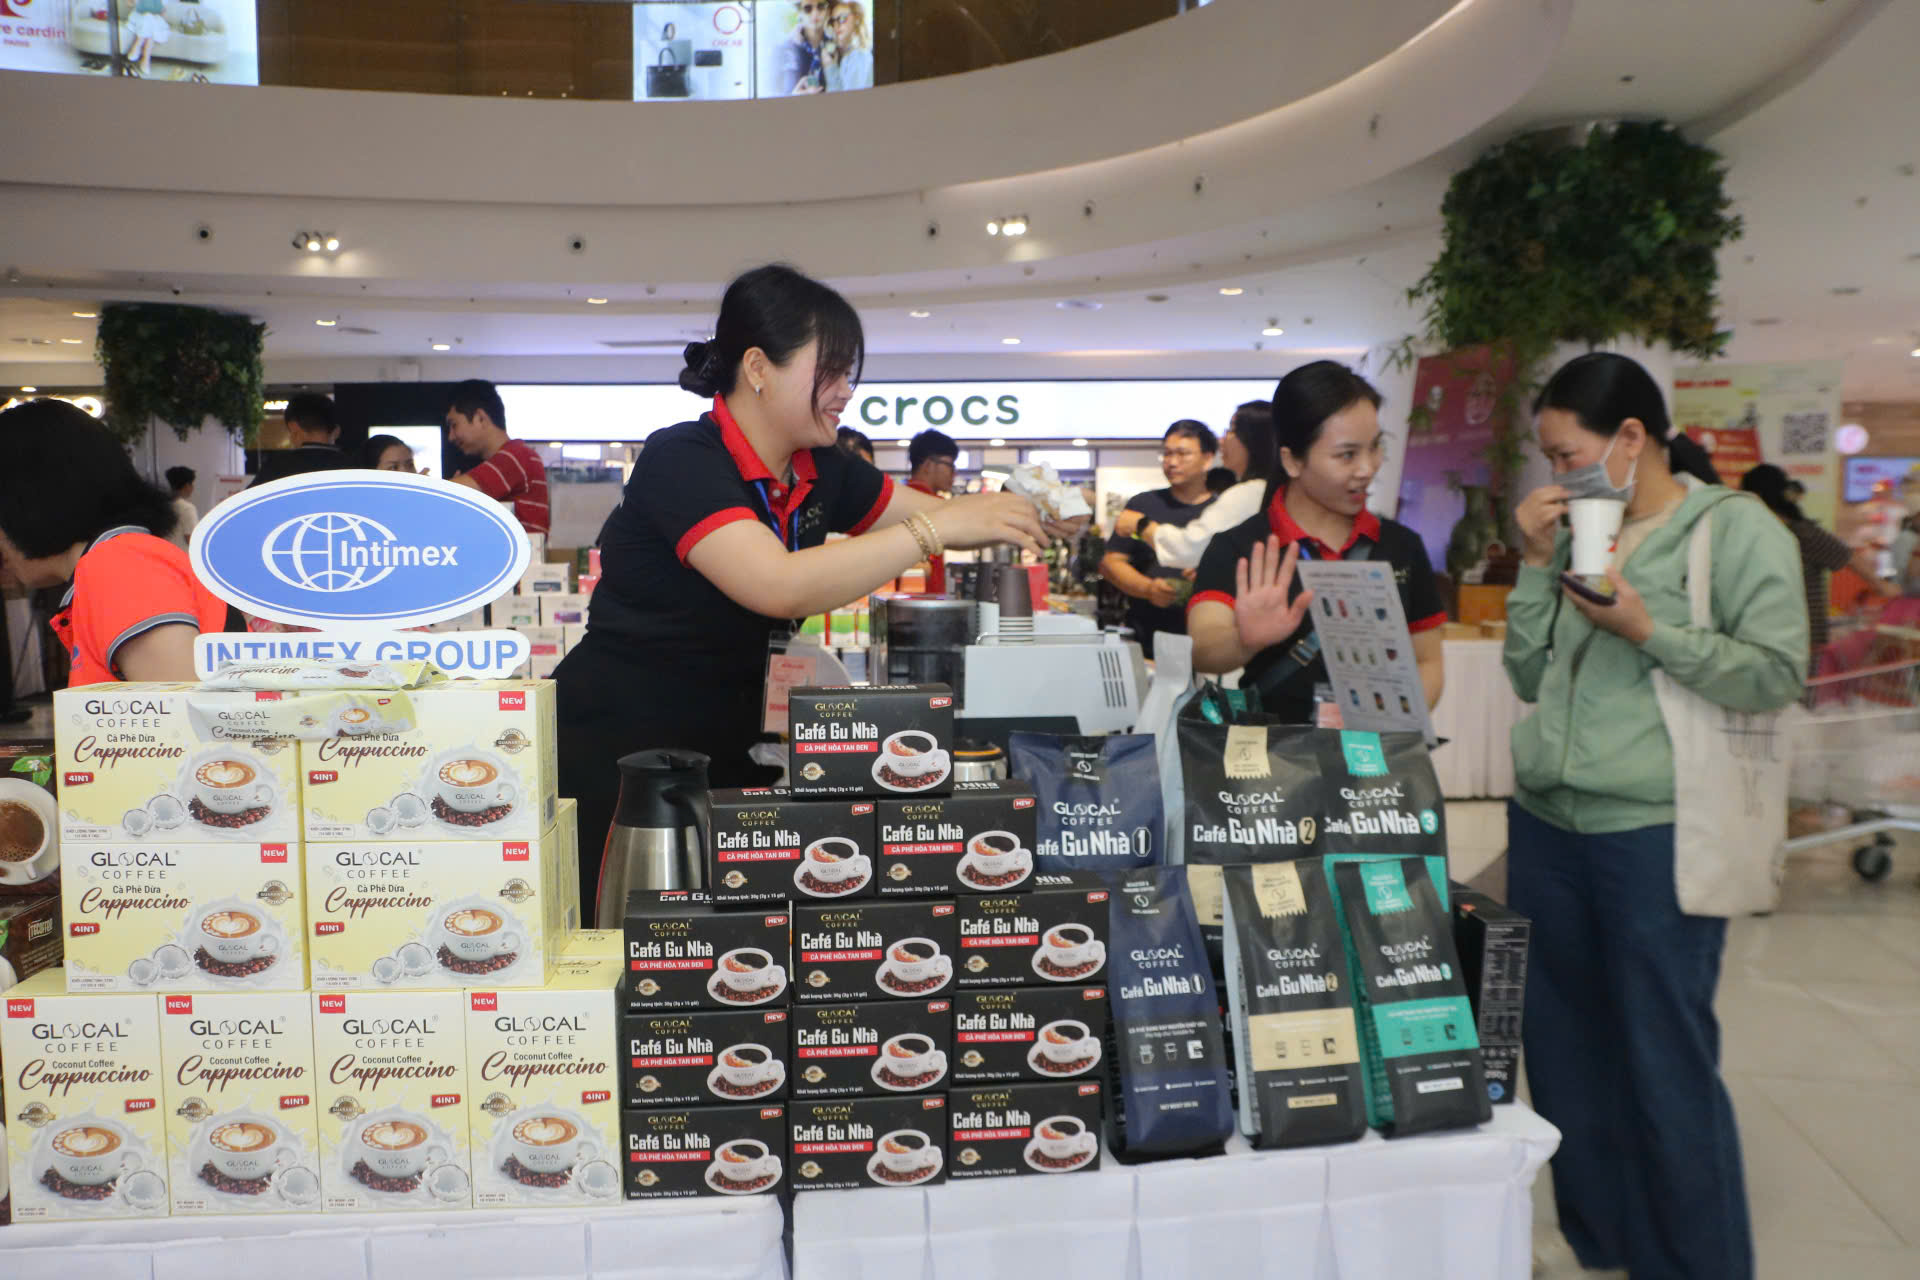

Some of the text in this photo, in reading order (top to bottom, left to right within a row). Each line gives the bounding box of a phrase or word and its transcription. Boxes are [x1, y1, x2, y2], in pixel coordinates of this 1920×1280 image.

[16, 26, 66, 39] cardin
[860, 394, 1020, 426] crocs
[341, 540, 458, 566] Intimex
[376, 640, 518, 670] GROUP
[85, 700, 171, 715] GLOCAL
[218, 711, 271, 720] GLOCAL
[96, 718, 160, 728] COFFEE
[796, 722, 878, 740] Café Gu Nhà
[74, 736, 186, 768] Cappuccino
[319, 738, 428, 768] Cappuccino
[1218, 791, 1284, 805] GLOCAL
[1340, 786, 1404, 800] GLOCAL
[1053, 802, 1121, 816] GLOCAL
[1227, 806, 1278, 814] COFFEE
[1348, 798, 1398, 808] COFFEE
[1062, 817, 1113, 826] COFFEE
[1350, 811, 1380, 834] Gu
[1378, 809, 1420, 834] Nhà
[883, 824, 963, 842] Café Gu Nhà
[1194, 825, 1226, 844] Café
[1228, 818, 1256, 844] Gu
[1256, 818, 1297, 844] Nhà
[718, 830, 800, 848] Café Gu Nhà
[1036, 840, 1058, 856] afé
[1062, 830, 1088, 856] Gu
[1090, 830, 1130, 856] Nhà
[91, 852, 176, 866] GLOCAL
[336, 852, 420, 866] GLOCAL
[505, 848, 526, 856] NEW
[102, 870, 166, 880] COFFEE
[347, 870, 410, 878] COFFEE
[126, 884, 142, 894] Phê
[144, 885, 161, 894] Dừa
[357, 884, 404, 894] Cà Phê Dừa
[80, 887, 191, 920] Cappuccino
[325, 886, 434, 918] Cappuccino
[74, 926, 96, 934] 4IN1
[320, 924, 340, 932] 4IN1
[961, 917, 1039, 935] Café Gu Nhà
[802, 931, 882, 950] Café Gu Nhà
[630, 940, 713, 958] Café Gu Nhà
[1130, 948, 1184, 961] GLOCAL
[1268, 948, 1320, 960] GLOCAL
[1380, 944, 1432, 956] GLOCAL
[1138, 960, 1180, 969] COFFEE
[1275, 960, 1316, 968] COFFEE
[1388, 952, 1428, 964] COFFEE
[1394, 968, 1417, 986] Gu
[1413, 964, 1442, 983] Nhà
[1120, 985, 1144, 1000] Café
[1144, 977, 1162, 996] Gu
[1162, 976, 1190, 995] Nhà
[1279, 976, 1300, 996] Gu
[1299, 974, 1326, 993] Nhà
[190, 1019, 283, 1036] GLOCAL
[342, 1018, 436, 1034] GLOCAL
[494, 1016, 586, 1032] GLOCAL
[957, 1013, 1035, 1030] Café Gu Nhà
[32, 1022, 128, 1040] GLOCAL
[798, 1027, 878, 1046] Café Gu Nhà
[202, 1038, 272, 1050] COFFEE
[355, 1038, 425, 1048] COFFEE
[506, 1035, 576, 1046] COFFEE
[631, 1038, 713, 1055] Café Gu Nhà
[44, 1042, 118, 1054] COFFEE
[209, 1056, 270, 1064] Coconut Coffee
[362, 1055, 422, 1064] Coconut Coffee
[513, 1052, 573, 1061] Coconut Coffee
[52, 1059, 115, 1069] Coconut Coffee
[481, 1050, 609, 1088] Cappuccino
[18, 1058, 152, 1097] Cappuccino
[176, 1054, 307, 1093] Cappuccino
[330, 1054, 459, 1092] Cappuccino
[284, 1098, 305, 1106] 4IN1
[435, 1096, 456, 1104] 4IN1
[585, 1092, 606, 1100] 4IN1
[129, 1100, 151, 1109] 4IN1
[953, 1110, 1030, 1129] Café Gu Nhà
[794, 1123, 873, 1141] Café Gu Nhà
[630, 1133, 710, 1150] Café Gu Nhà
